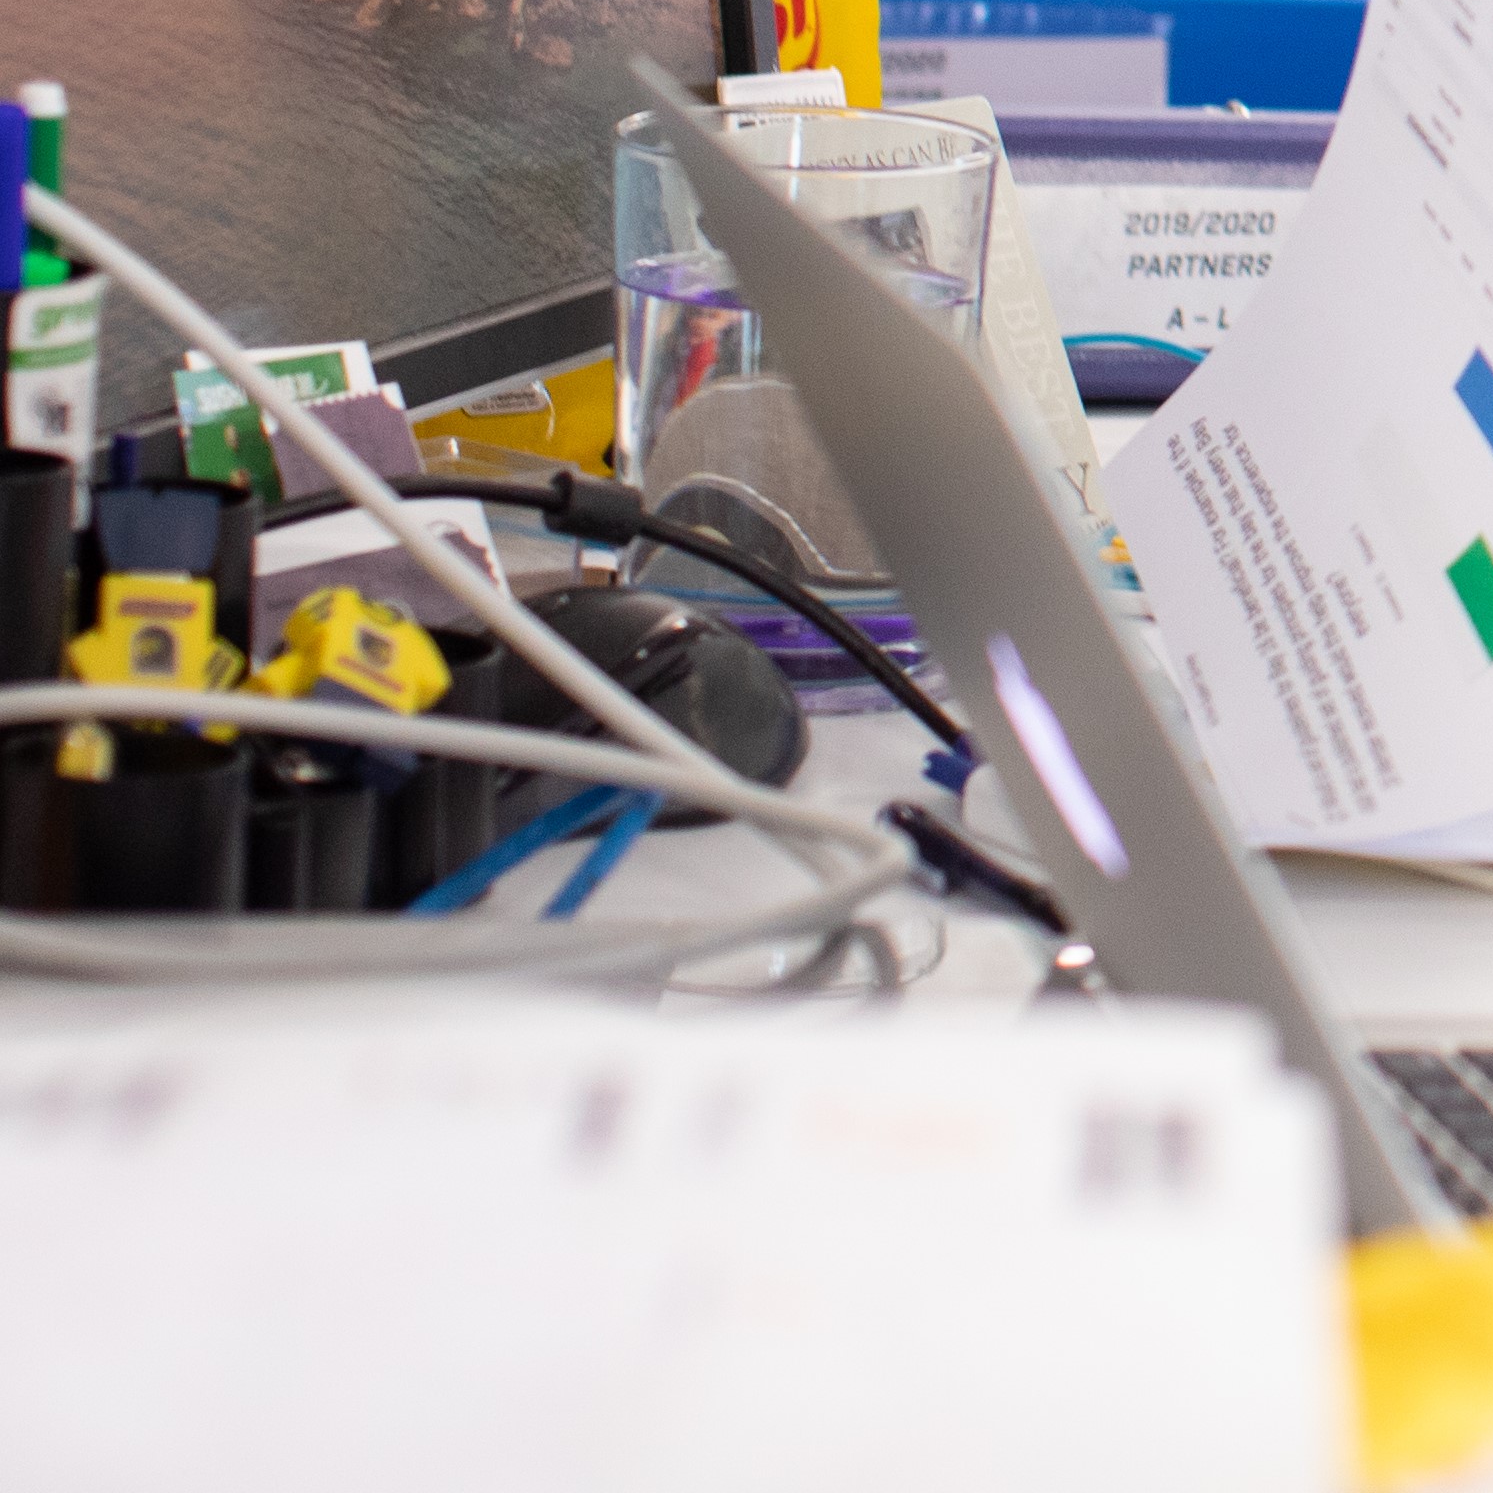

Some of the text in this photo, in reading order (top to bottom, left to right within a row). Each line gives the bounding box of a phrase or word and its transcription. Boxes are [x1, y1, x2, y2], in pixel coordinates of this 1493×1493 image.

[1124, 211, 1277, 238] 2019/2020
[1126, 252, 1274, 279] PARTNERS
[1165, 306, 1187, 332] A
[1216, 306, 1231, 330] L
